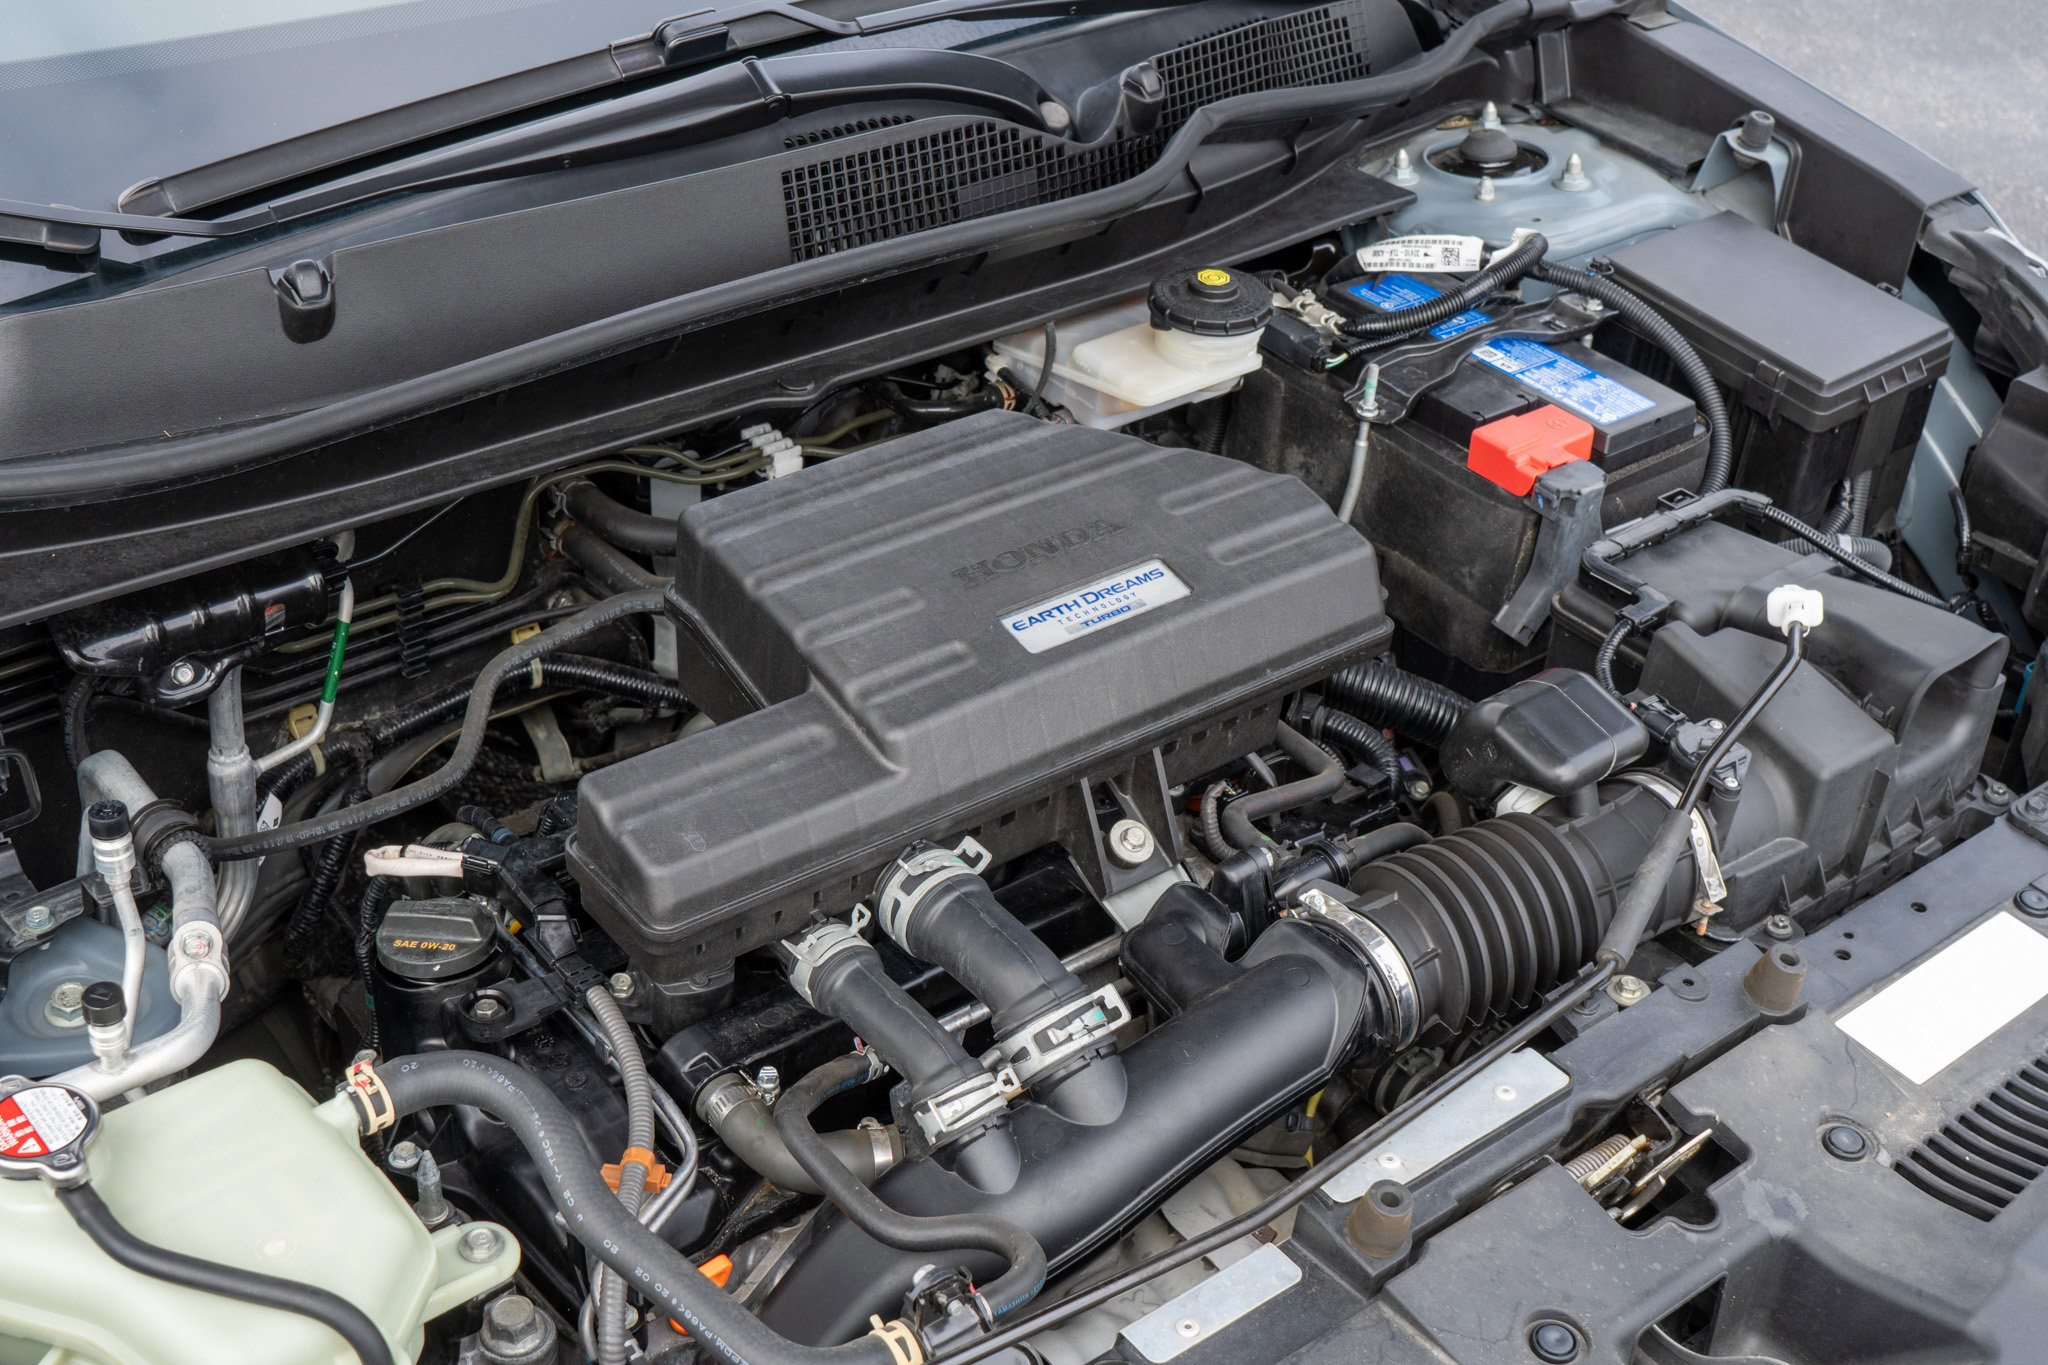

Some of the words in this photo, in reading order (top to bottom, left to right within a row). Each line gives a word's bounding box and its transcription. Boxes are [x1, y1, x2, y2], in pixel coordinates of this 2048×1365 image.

[951, 518, 1127, 588] HONDA
[1012, 599, 1080, 631] EARTH
[1079, 568, 1165, 608] DREAMS
[1058, 592, 1137, 625] TECHNOLOGY
[1081, 605, 1132, 627] TURBO
[393, 940, 418, 948] SAE
[420, 942, 456, 951] 0W-20
[541, 1138, 562, 1182] Y-TEC
[603, 1239, 619, 1254] 20
[653, 1281, 670, 1297] 20
